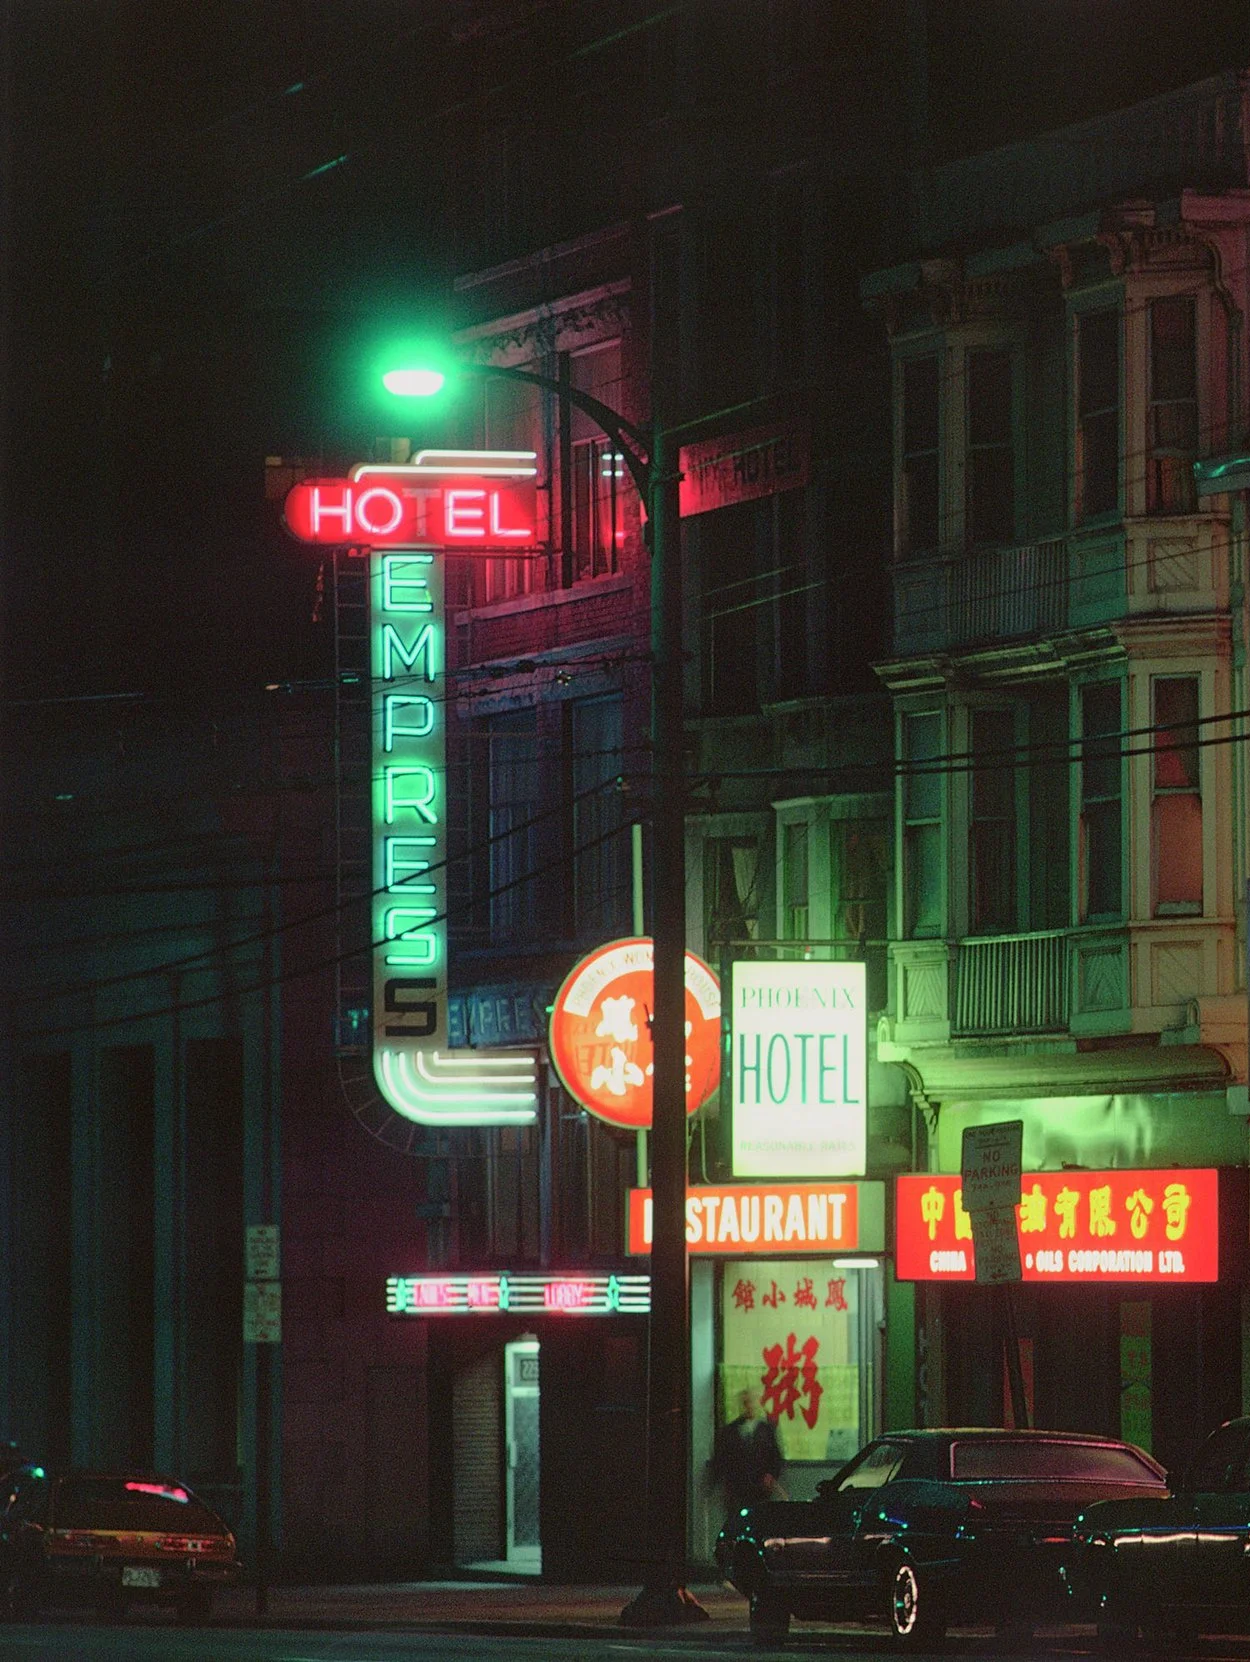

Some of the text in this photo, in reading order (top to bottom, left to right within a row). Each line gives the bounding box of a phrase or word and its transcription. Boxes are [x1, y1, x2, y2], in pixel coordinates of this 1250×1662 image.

[310, 486, 532, 537] HOTEL
[382, 554, 438, 1037] EMPRESS
[740, 986, 856, 1010] PHOENIX
[739, 1032, 860, 1105] HOTEL
[963, 1162, 1019, 1182] PARKING
[983, 1149, 1001, 1164] NO
[643, 1193, 847, 1243] STAURANT
[929, 1250, 967, 1272] CHINA
[1035, 1250, 1064, 1272] OILS
[1067, 1250, 1153, 1273] CORPORATION
[760, 1332, 824, 1430] 粥
